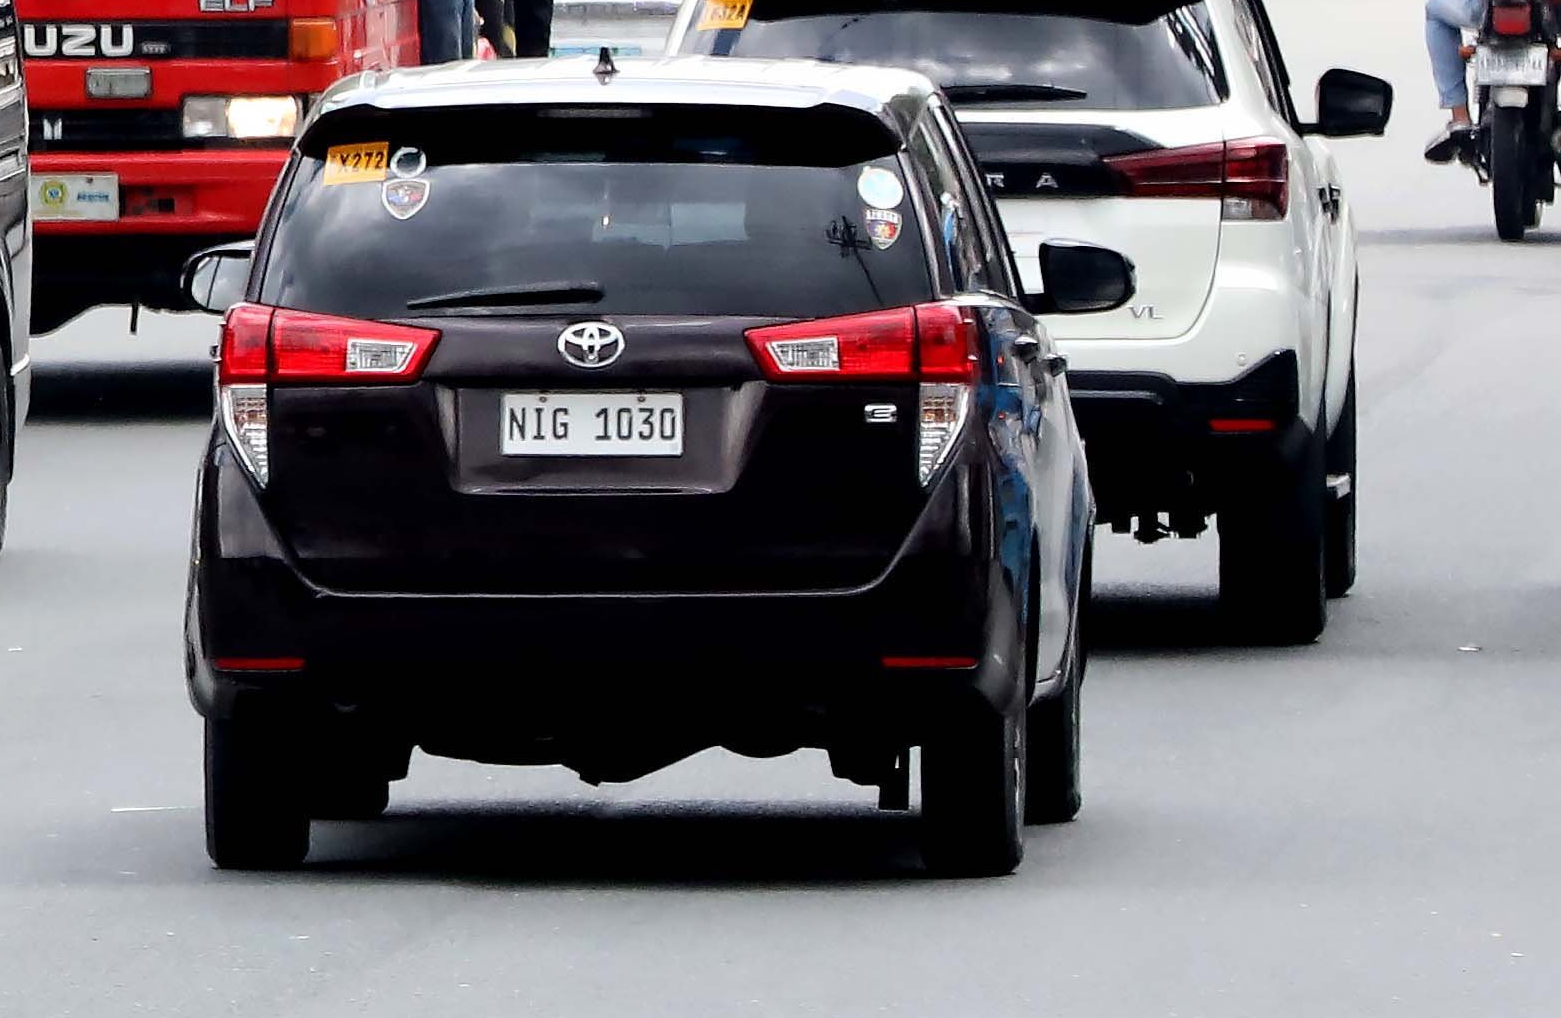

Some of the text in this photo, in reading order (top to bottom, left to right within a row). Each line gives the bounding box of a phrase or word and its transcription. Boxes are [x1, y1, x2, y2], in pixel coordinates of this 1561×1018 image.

[1128, 306, 1165, 320] VL
[508, 407, 677, 441] NIG 1030
